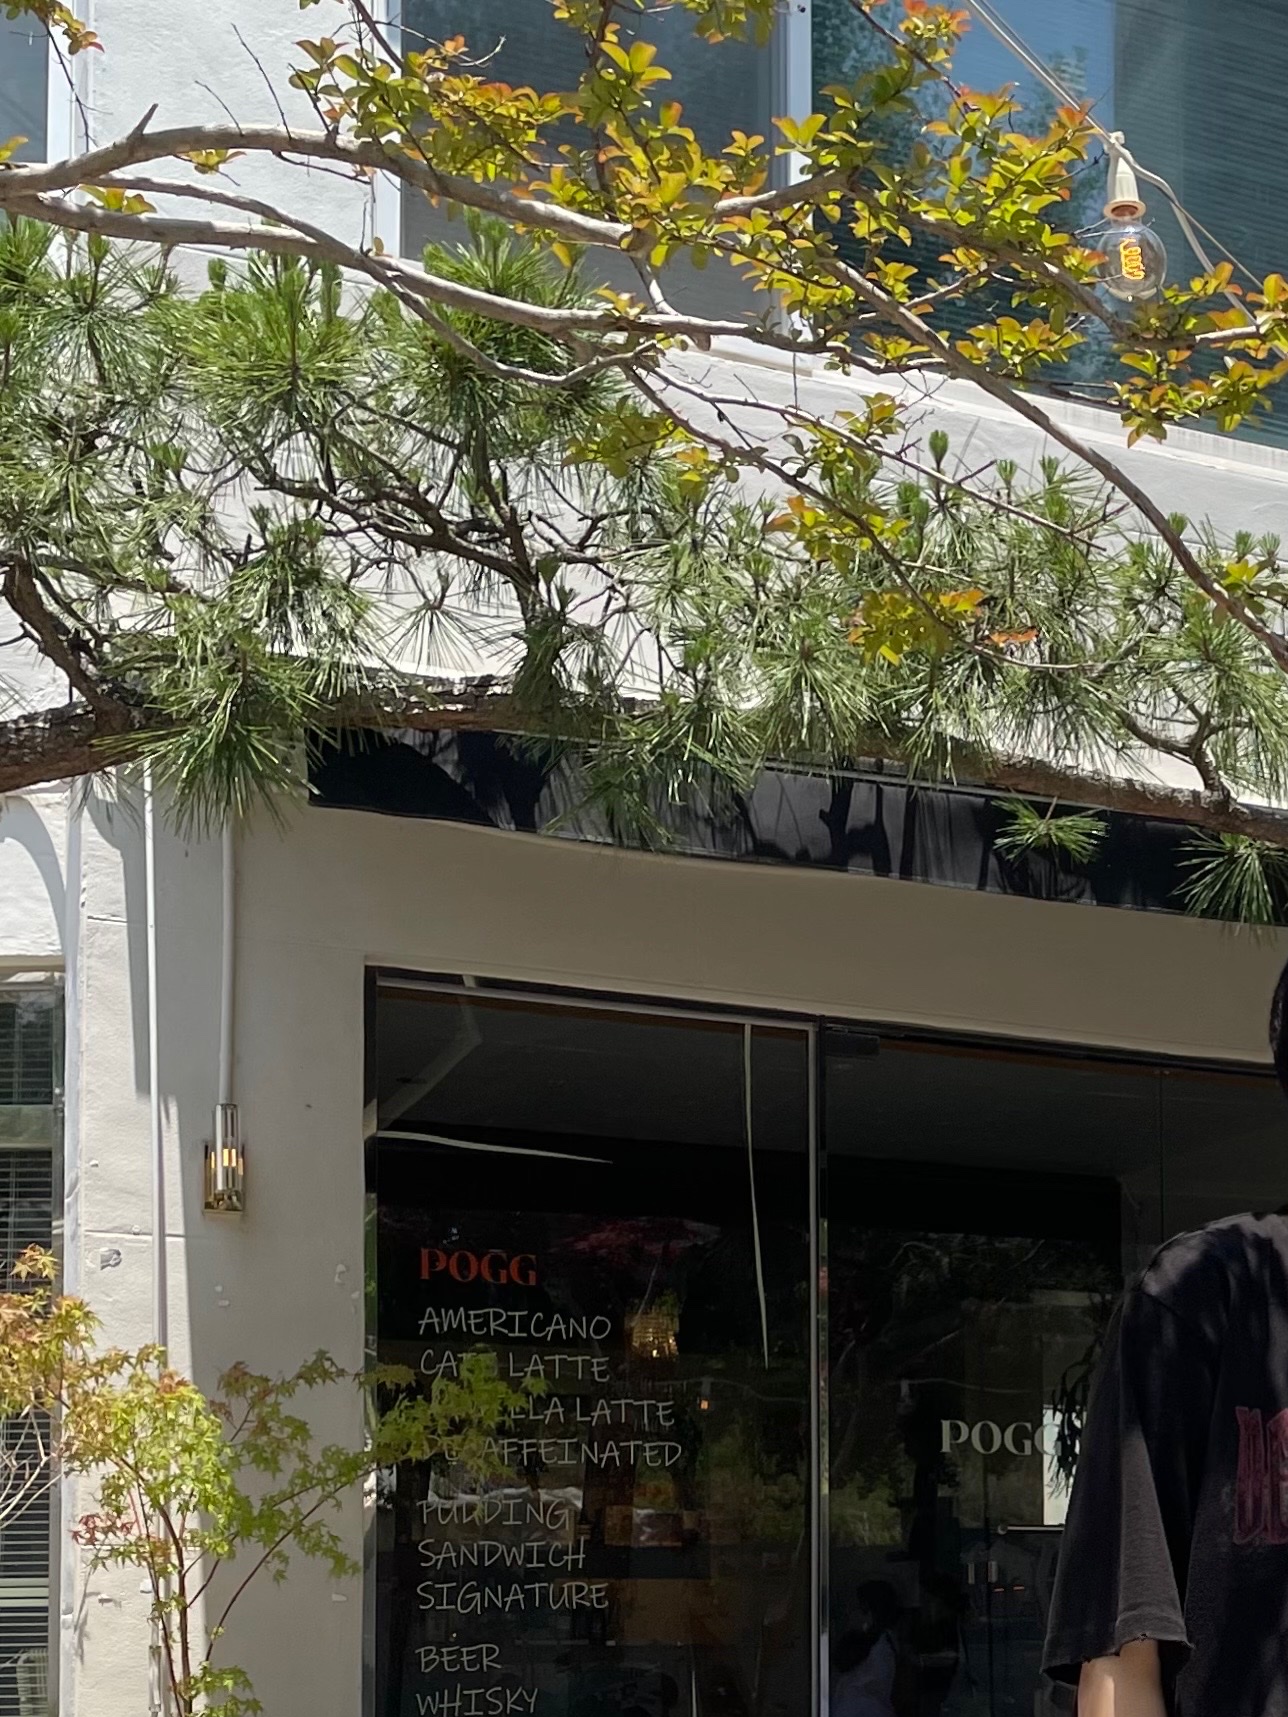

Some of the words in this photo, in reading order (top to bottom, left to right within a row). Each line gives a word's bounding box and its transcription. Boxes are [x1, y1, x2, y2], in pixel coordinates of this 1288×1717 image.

[418, 1247, 538, 1286] POGG
[417, 1306, 612, 1341] AMERICANO
[508, 1351, 611, 1382] LATTE
[575, 1397, 676, 1431] LATTE
[416, 1498, 570, 1531] PUDDING
[417, 1537, 586, 1571] SANDWICH
[415, 1580, 610, 1615] SIGNATURE
[415, 1643, 502, 1673] BEER
